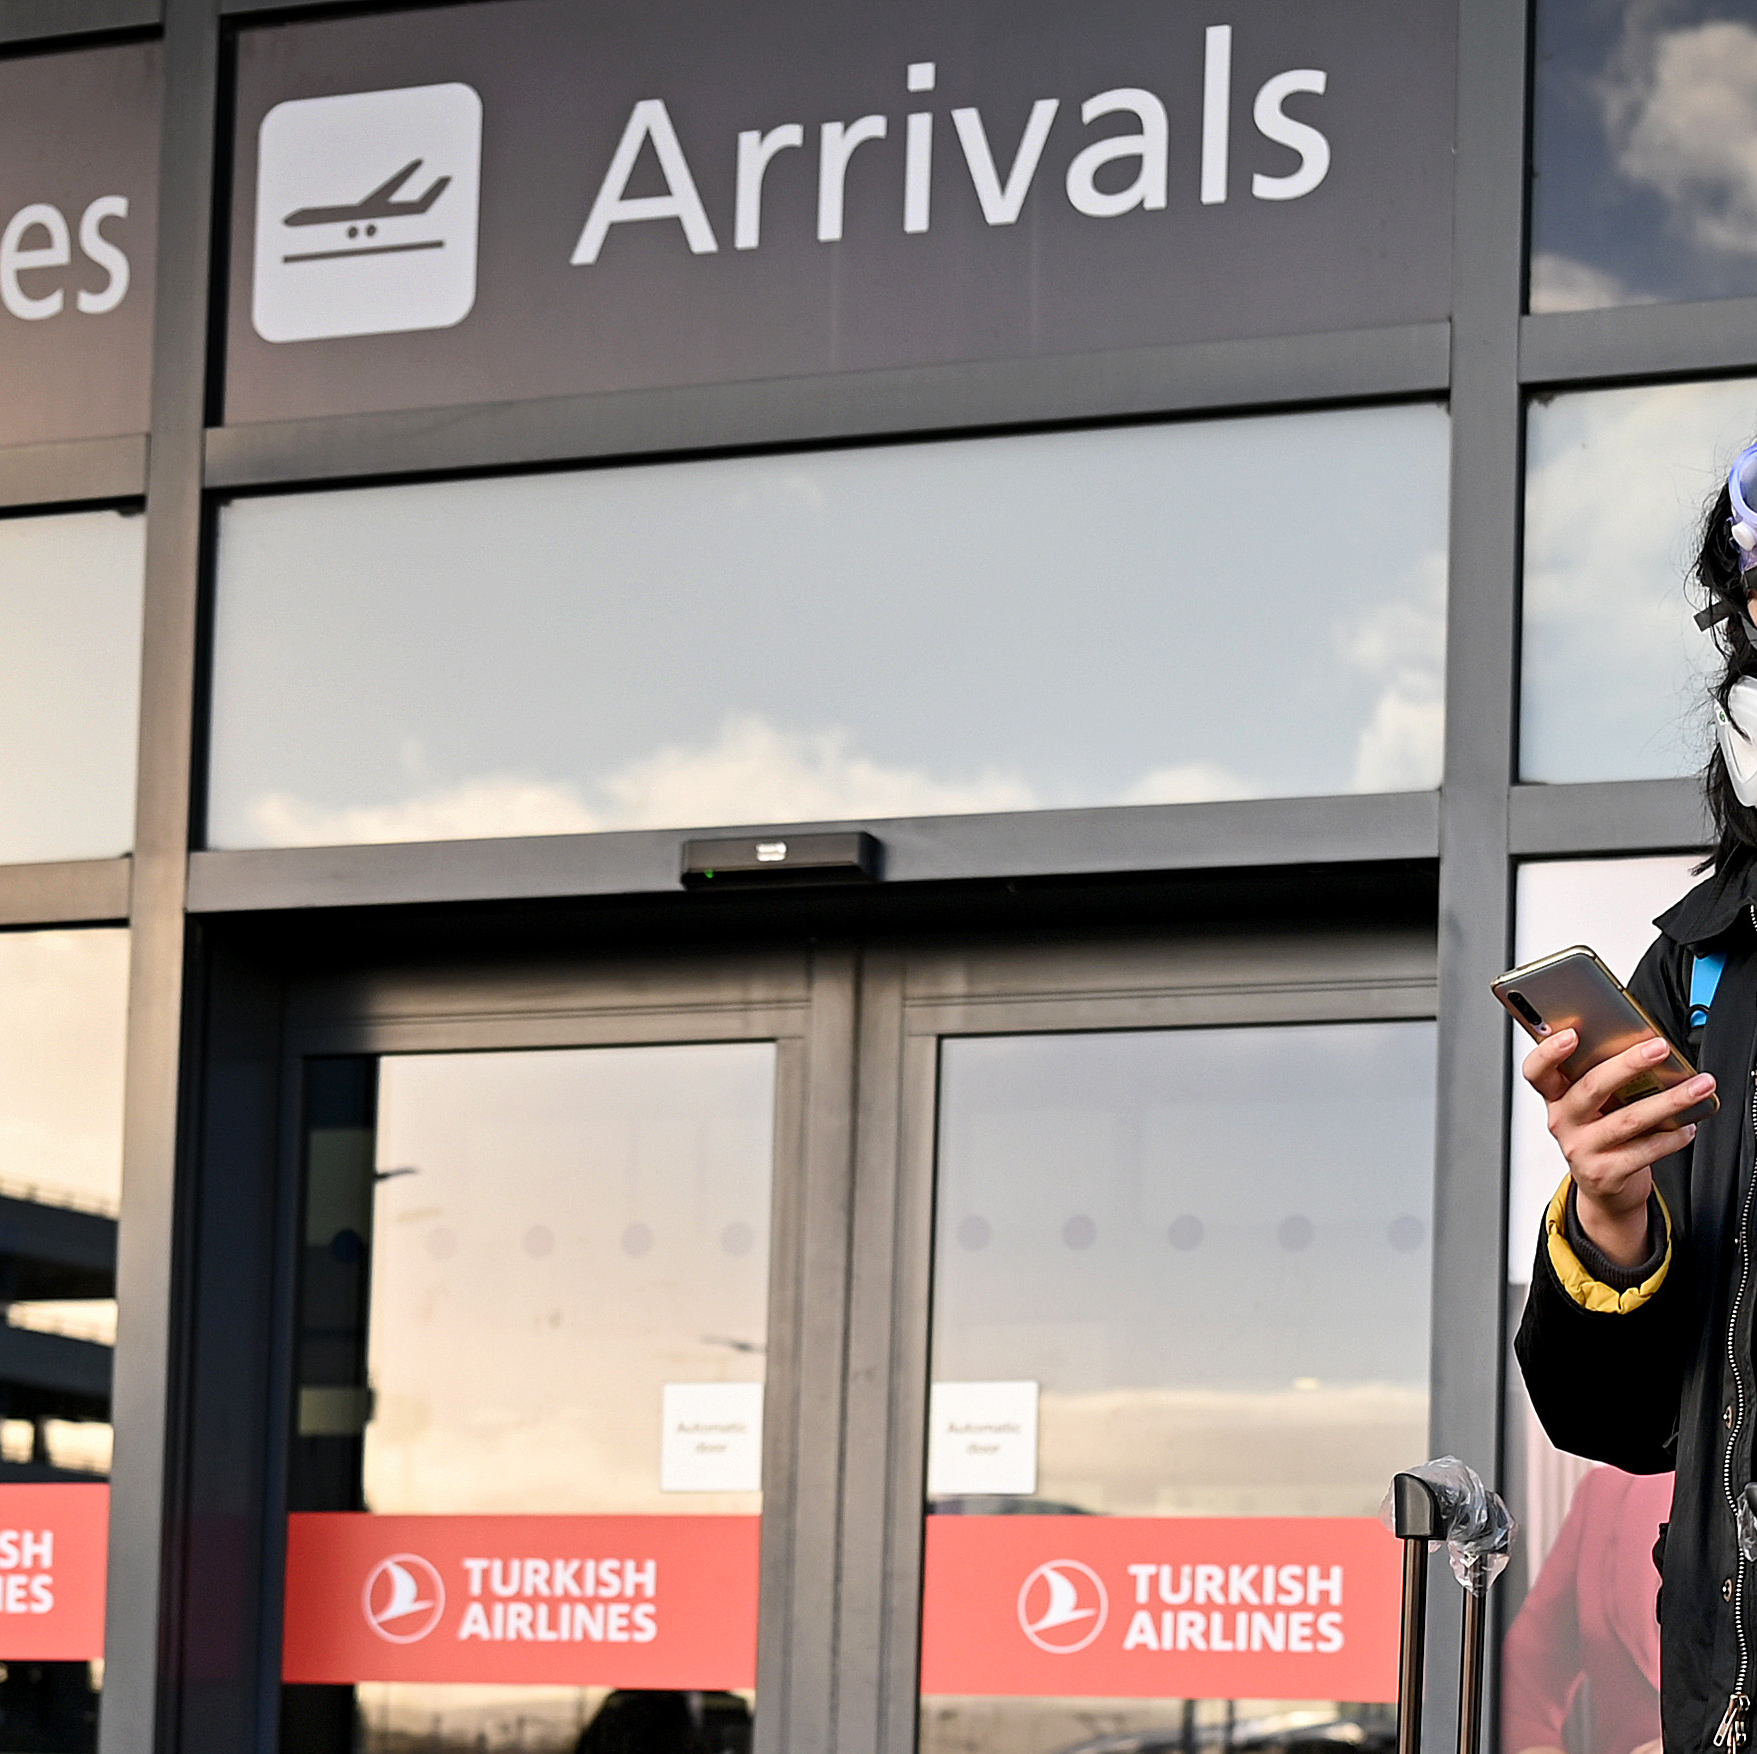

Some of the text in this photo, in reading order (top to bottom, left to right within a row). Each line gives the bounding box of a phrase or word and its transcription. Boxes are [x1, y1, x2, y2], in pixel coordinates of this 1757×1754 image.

[570, 24, 1331, 267] Arrivals
[463, 1558, 657, 1598] TURKISH
[1127, 1564, 1344, 1606] TURKISH
[457, 1602, 658, 1643] AIRLINES
[1122, 1610, 1345, 1654] AIRLINES
